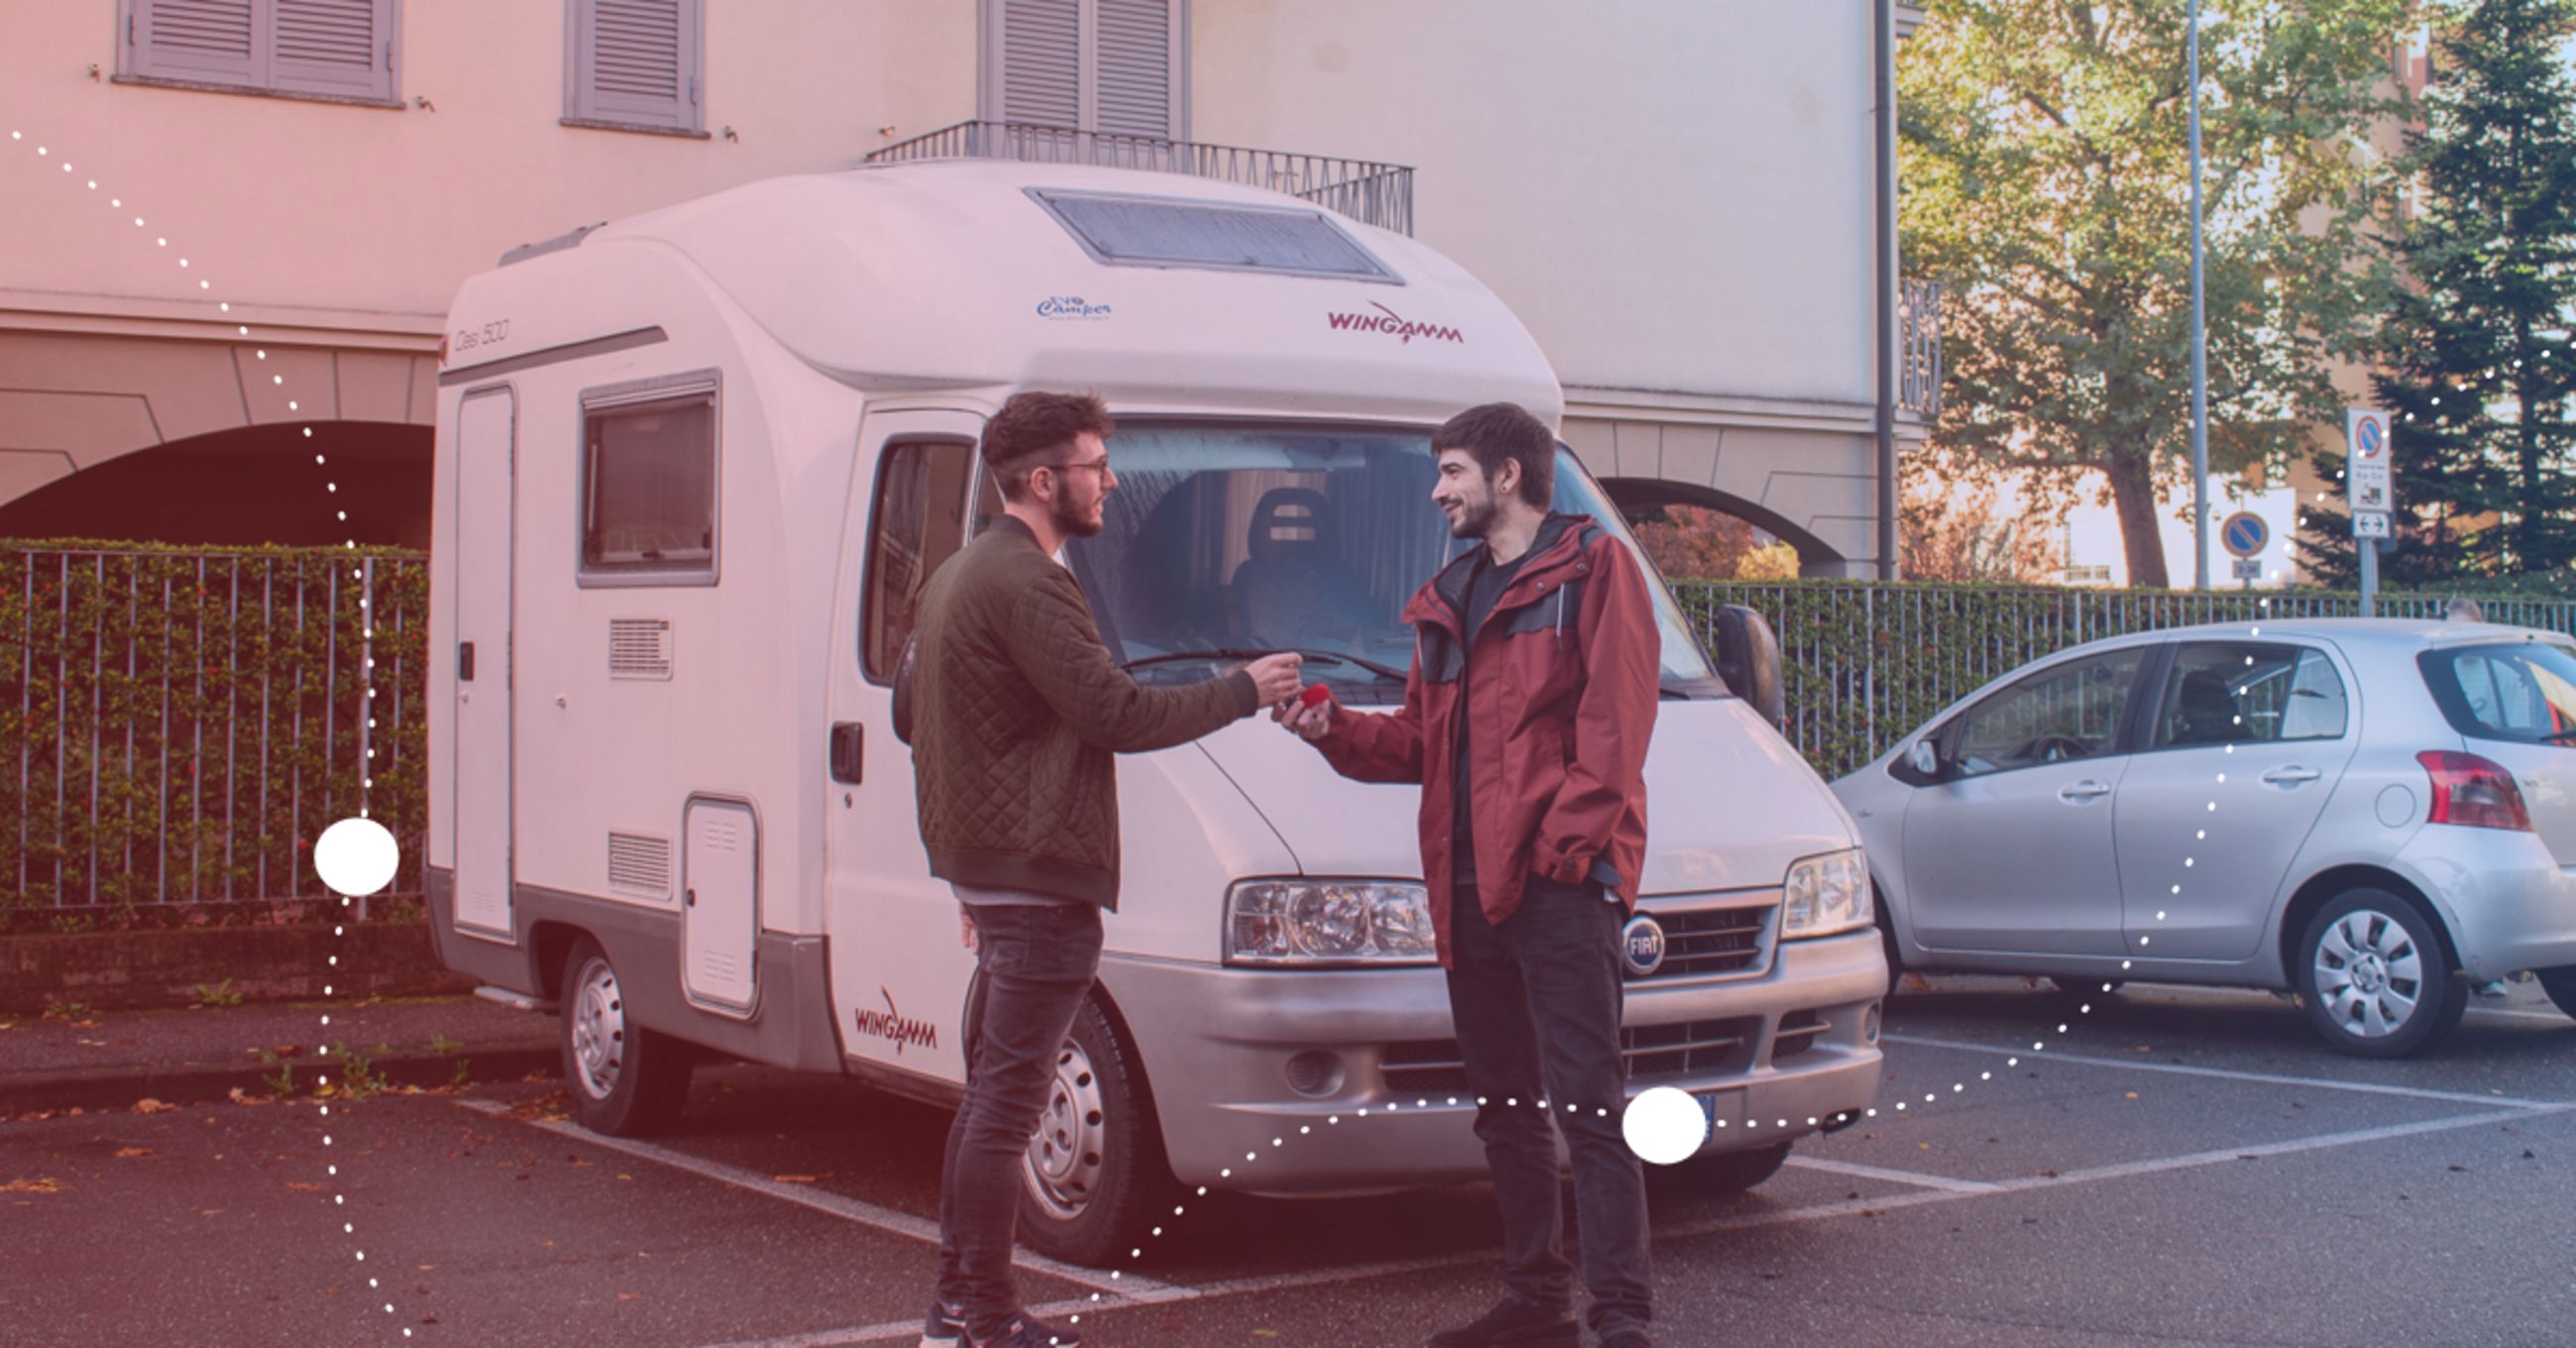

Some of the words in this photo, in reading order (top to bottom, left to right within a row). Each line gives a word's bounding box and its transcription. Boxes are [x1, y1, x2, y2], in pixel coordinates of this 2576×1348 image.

[1036, 299, 1111, 317] Camper
[1328, 298, 1464, 344] WINGAMM
[482, 317, 510, 345] 500
[1629, 935, 1658, 955] FIAT
[855, 984, 938, 1056] WINGAMM
